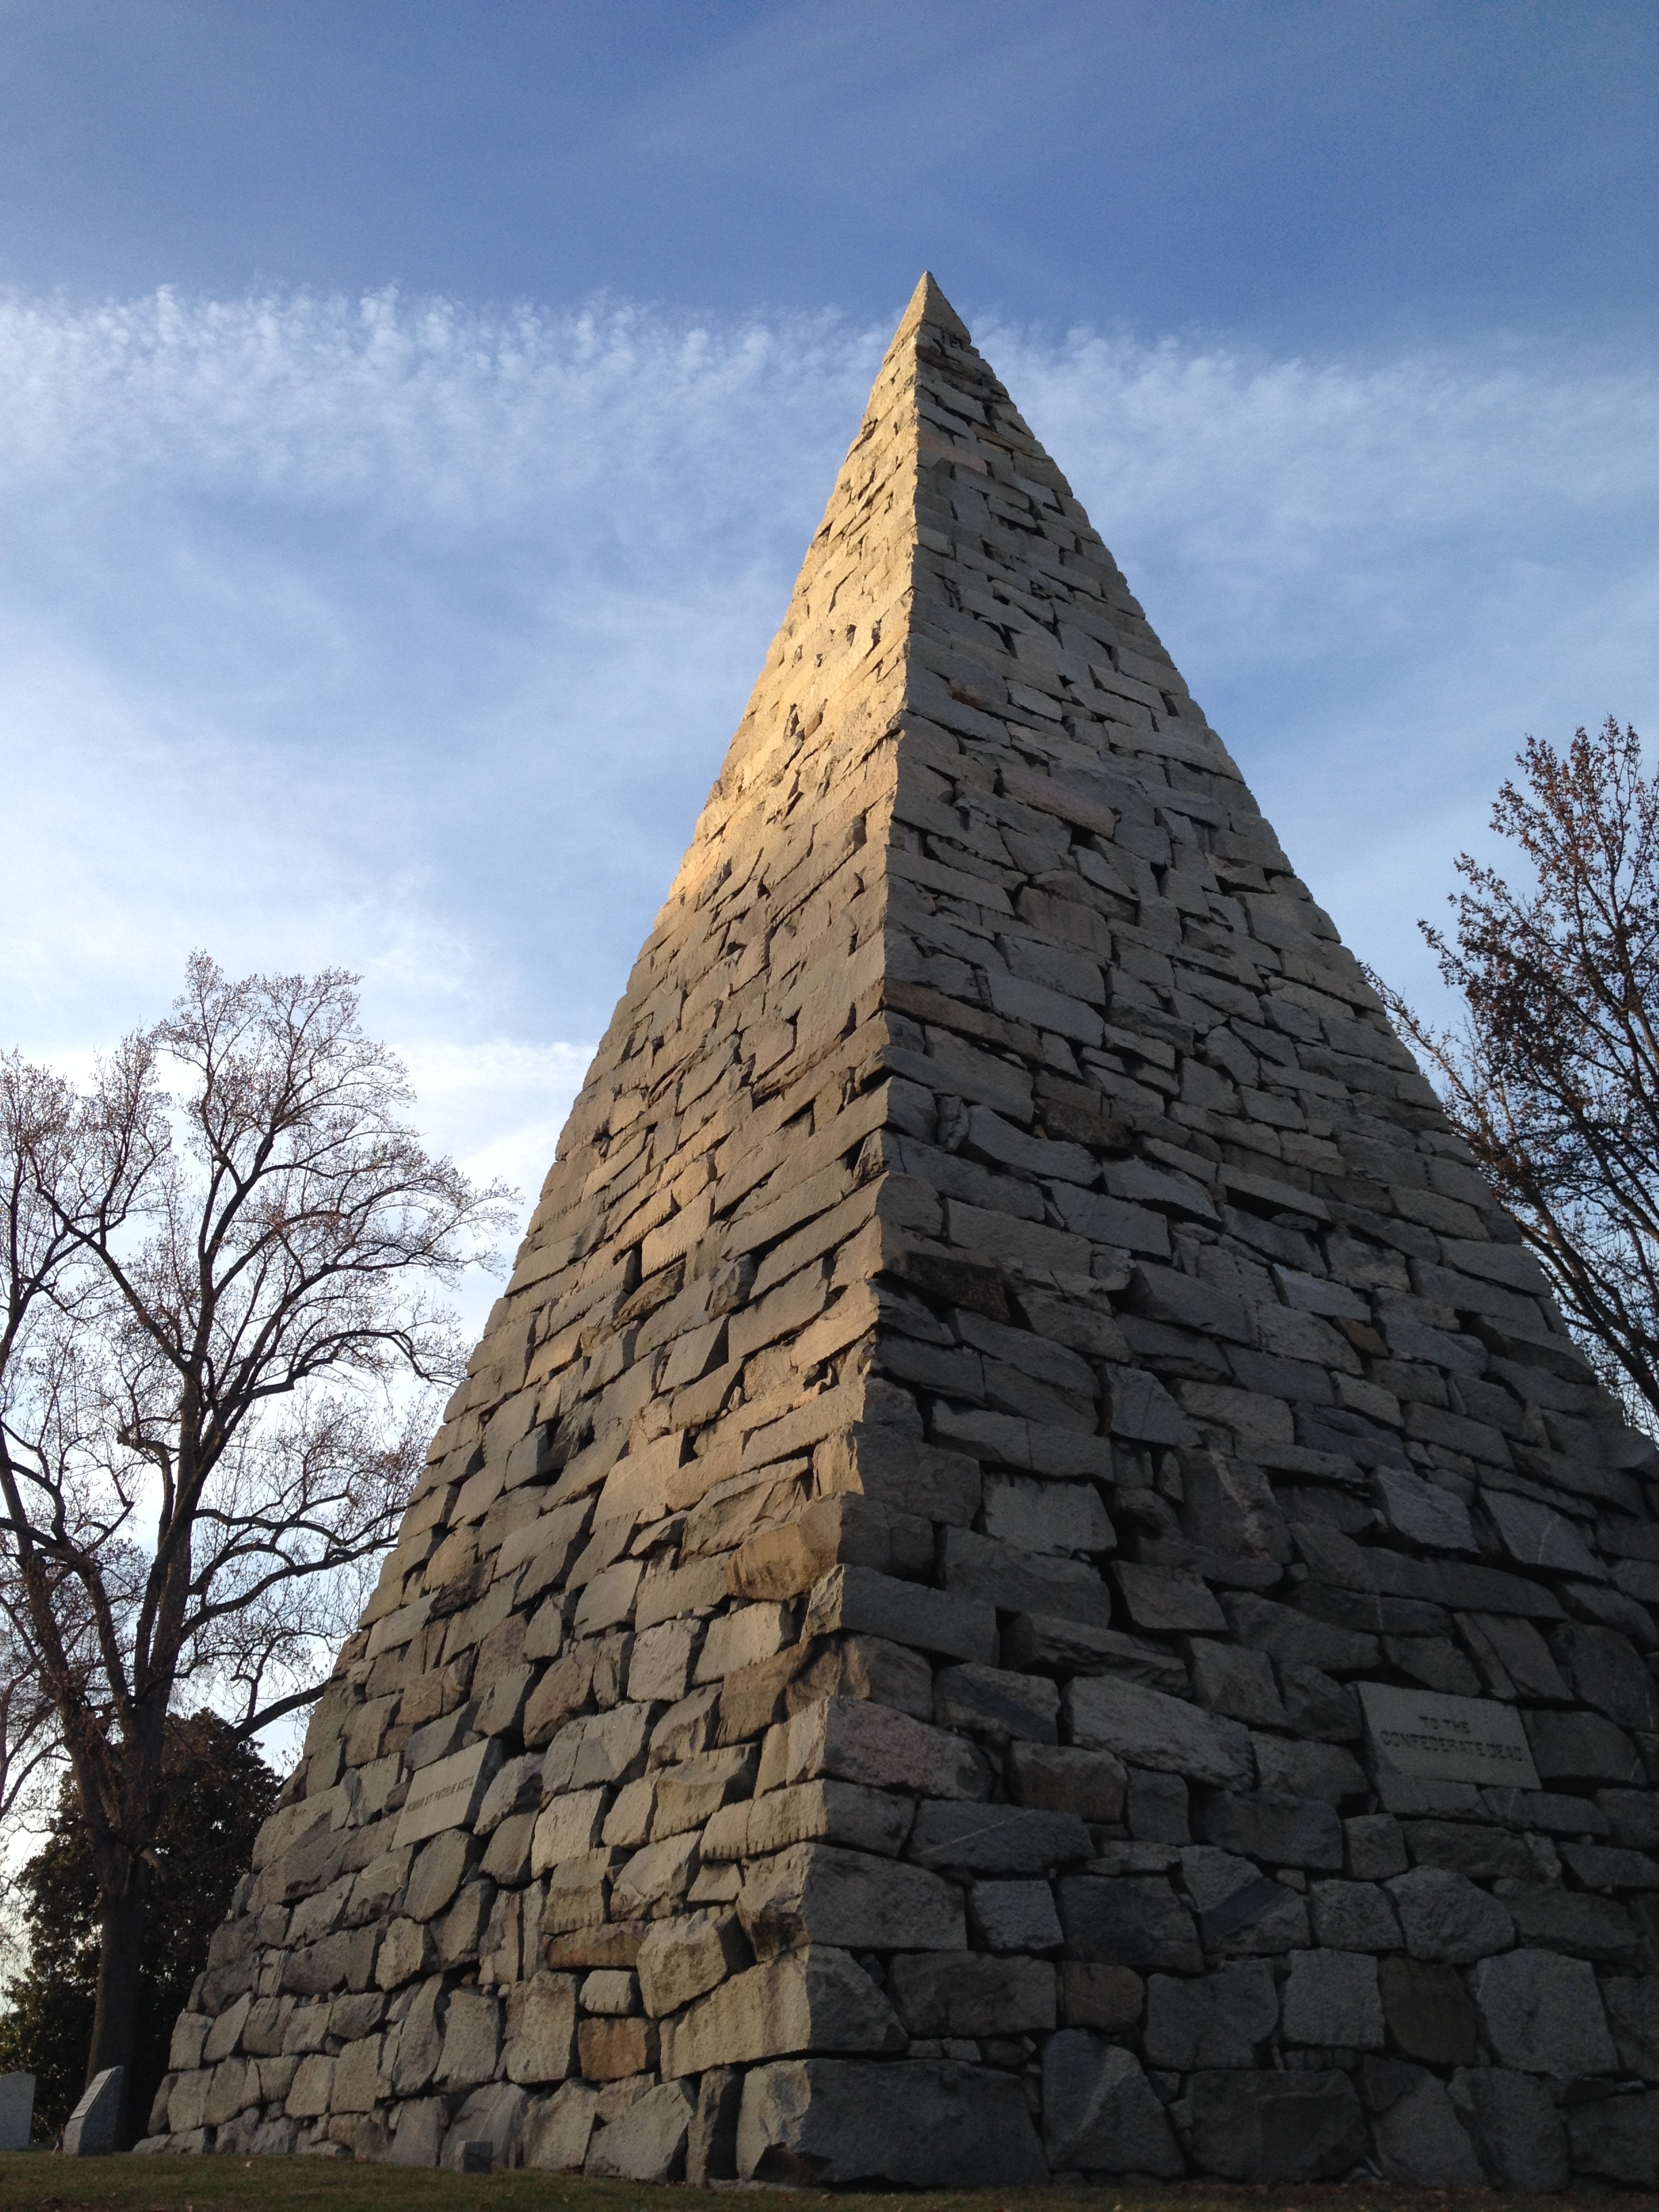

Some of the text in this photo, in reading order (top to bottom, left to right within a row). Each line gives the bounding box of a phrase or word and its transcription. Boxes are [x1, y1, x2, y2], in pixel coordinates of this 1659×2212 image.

[1418, 1715, 1471, 1735] TO THE
[1380, 1729, 1486, 1757] CONFEDERATE
